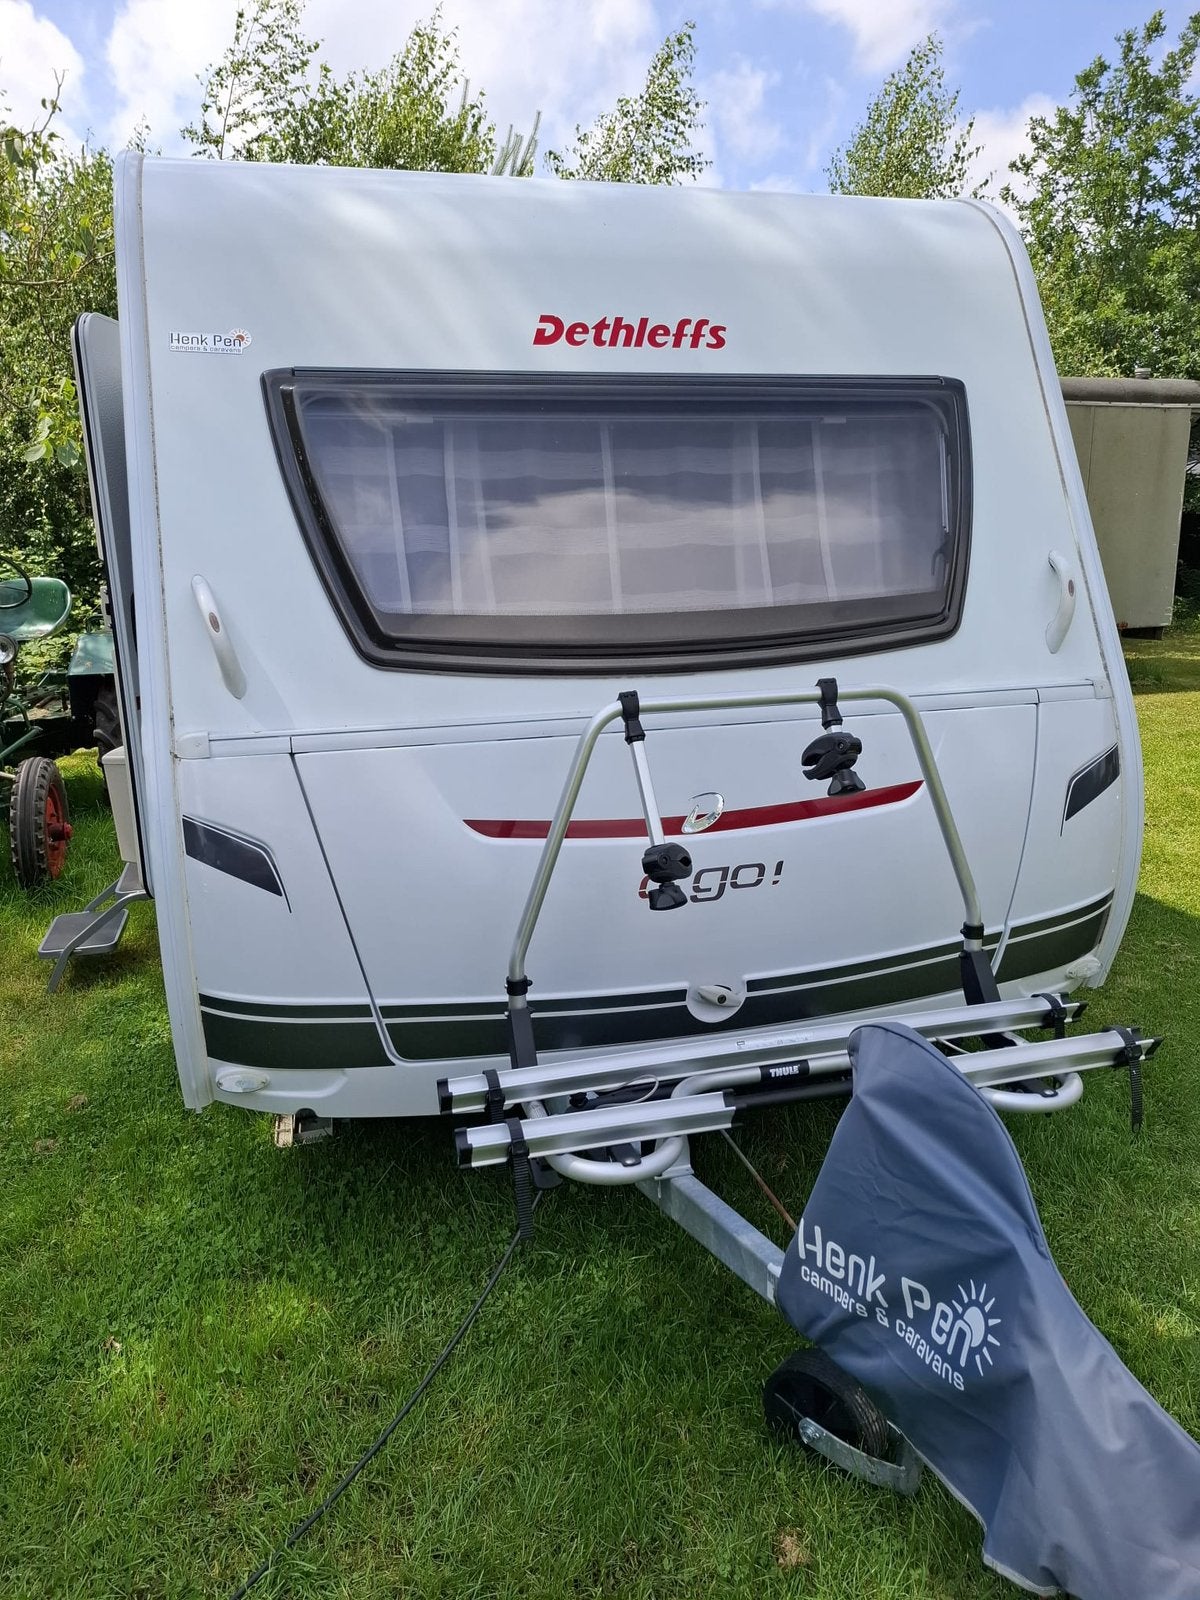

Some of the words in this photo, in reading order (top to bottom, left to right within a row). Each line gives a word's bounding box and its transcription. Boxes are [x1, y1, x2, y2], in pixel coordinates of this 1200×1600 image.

[170, 332, 208, 346] Henk
[213, 334, 242, 347] Pen
[533, 314, 727, 350] Dethleffs
[769, 1065, 799, 1078] THULE
[798, 1217, 888, 1308] Henk
[901, 1276, 972, 1367] Pen
[801, 1265, 868, 1318] campers
[875, 1306, 890, 1328] &
[895, 1319, 965, 1391] caravans
